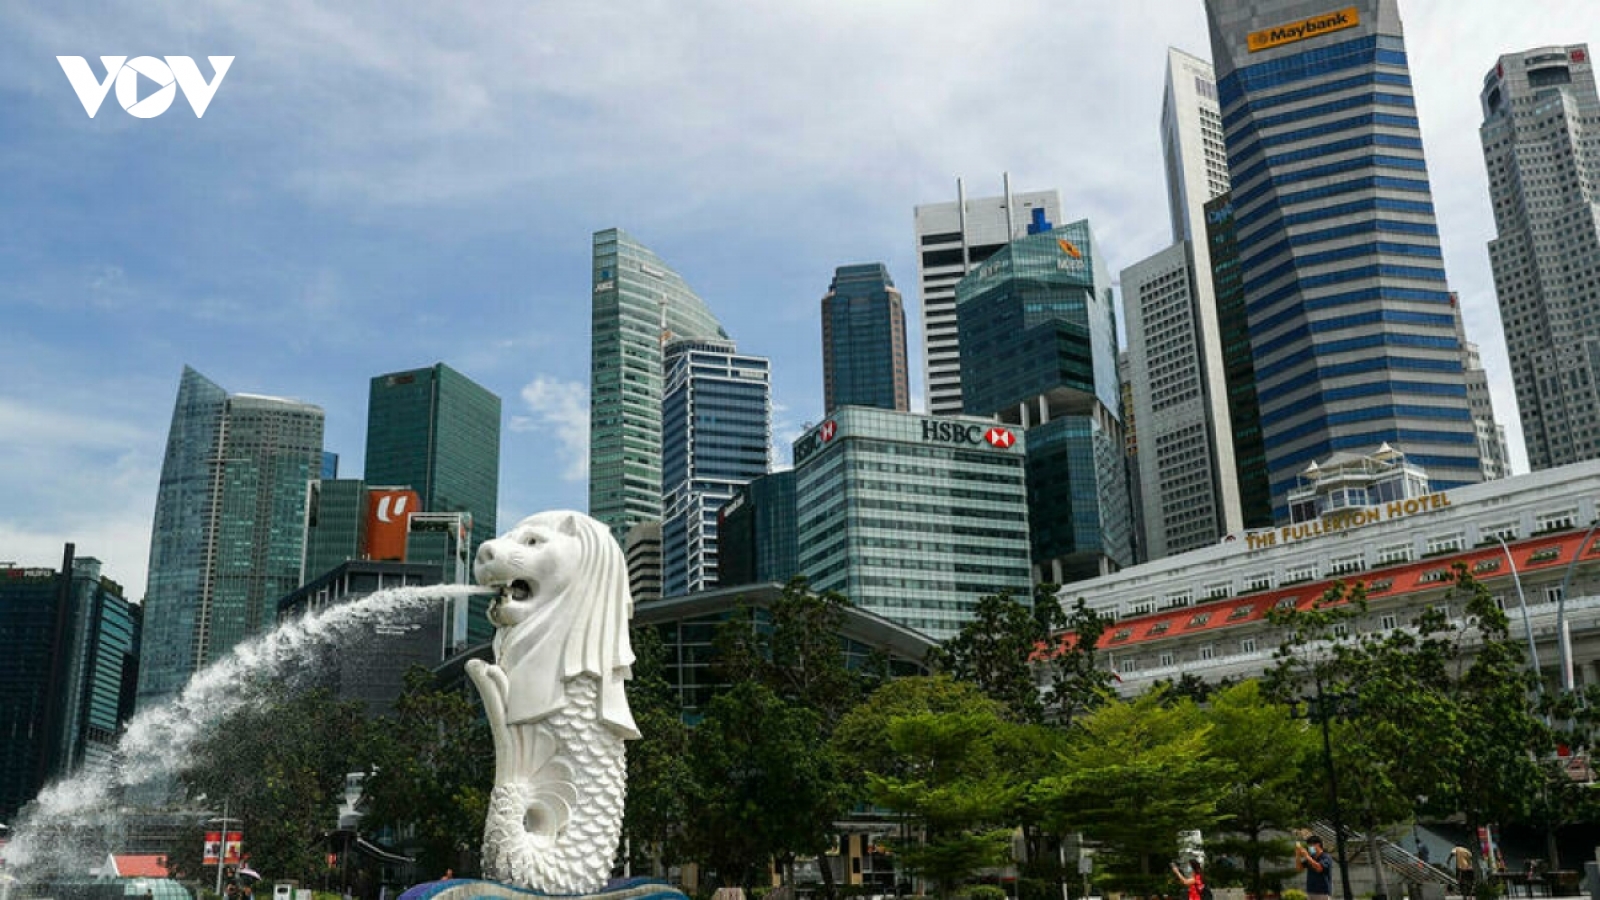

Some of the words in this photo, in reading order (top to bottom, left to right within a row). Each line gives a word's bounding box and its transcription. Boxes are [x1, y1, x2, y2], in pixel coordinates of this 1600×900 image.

[1270, 13, 1348, 41] Maybank
[921, 419, 981, 445] HSBC
[1246, 531, 1275, 550] THE
[1282, 508, 1380, 542] FULLERTON
[1387, 492, 1451, 518] HOTEL
